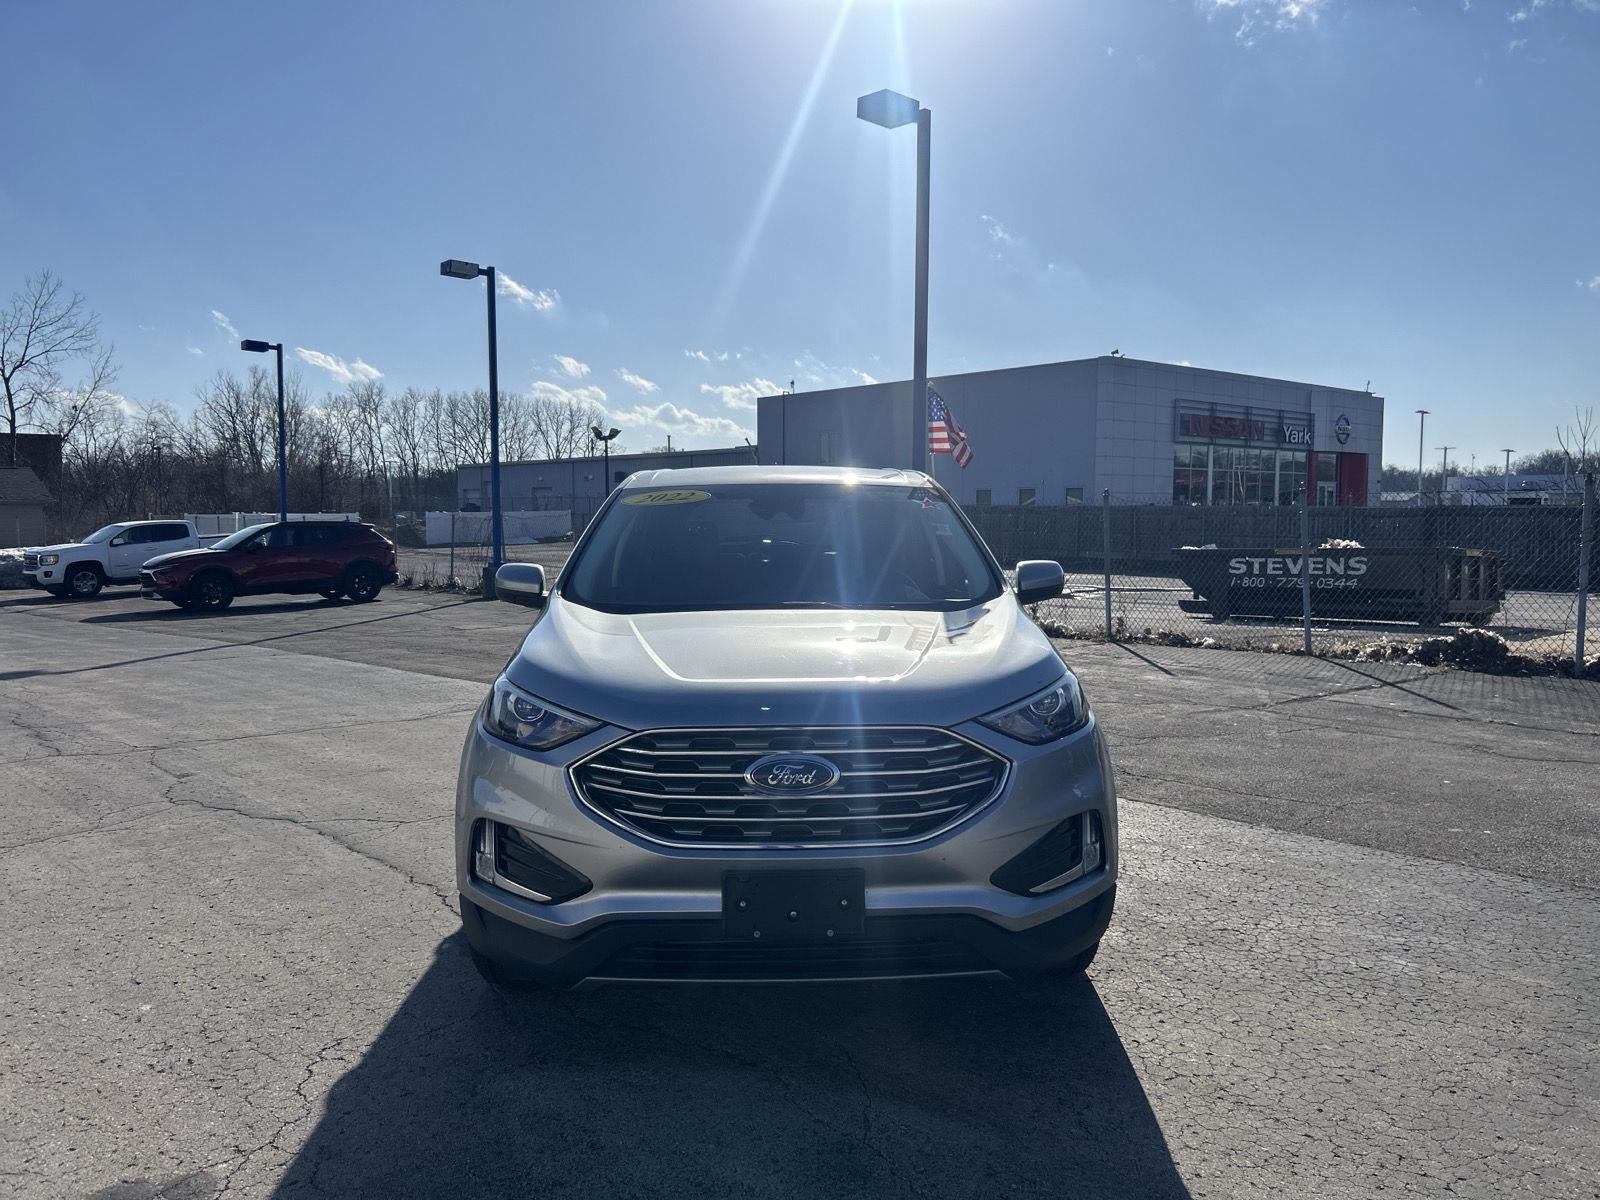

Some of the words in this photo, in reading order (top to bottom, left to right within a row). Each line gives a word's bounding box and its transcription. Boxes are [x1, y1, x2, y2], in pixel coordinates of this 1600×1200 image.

[1283, 425, 1311, 444] Yark
[635, 492, 696, 503] 2022
[1228, 557, 1368, 575] STEVENS
[767, 764, 817, 785] Ford
